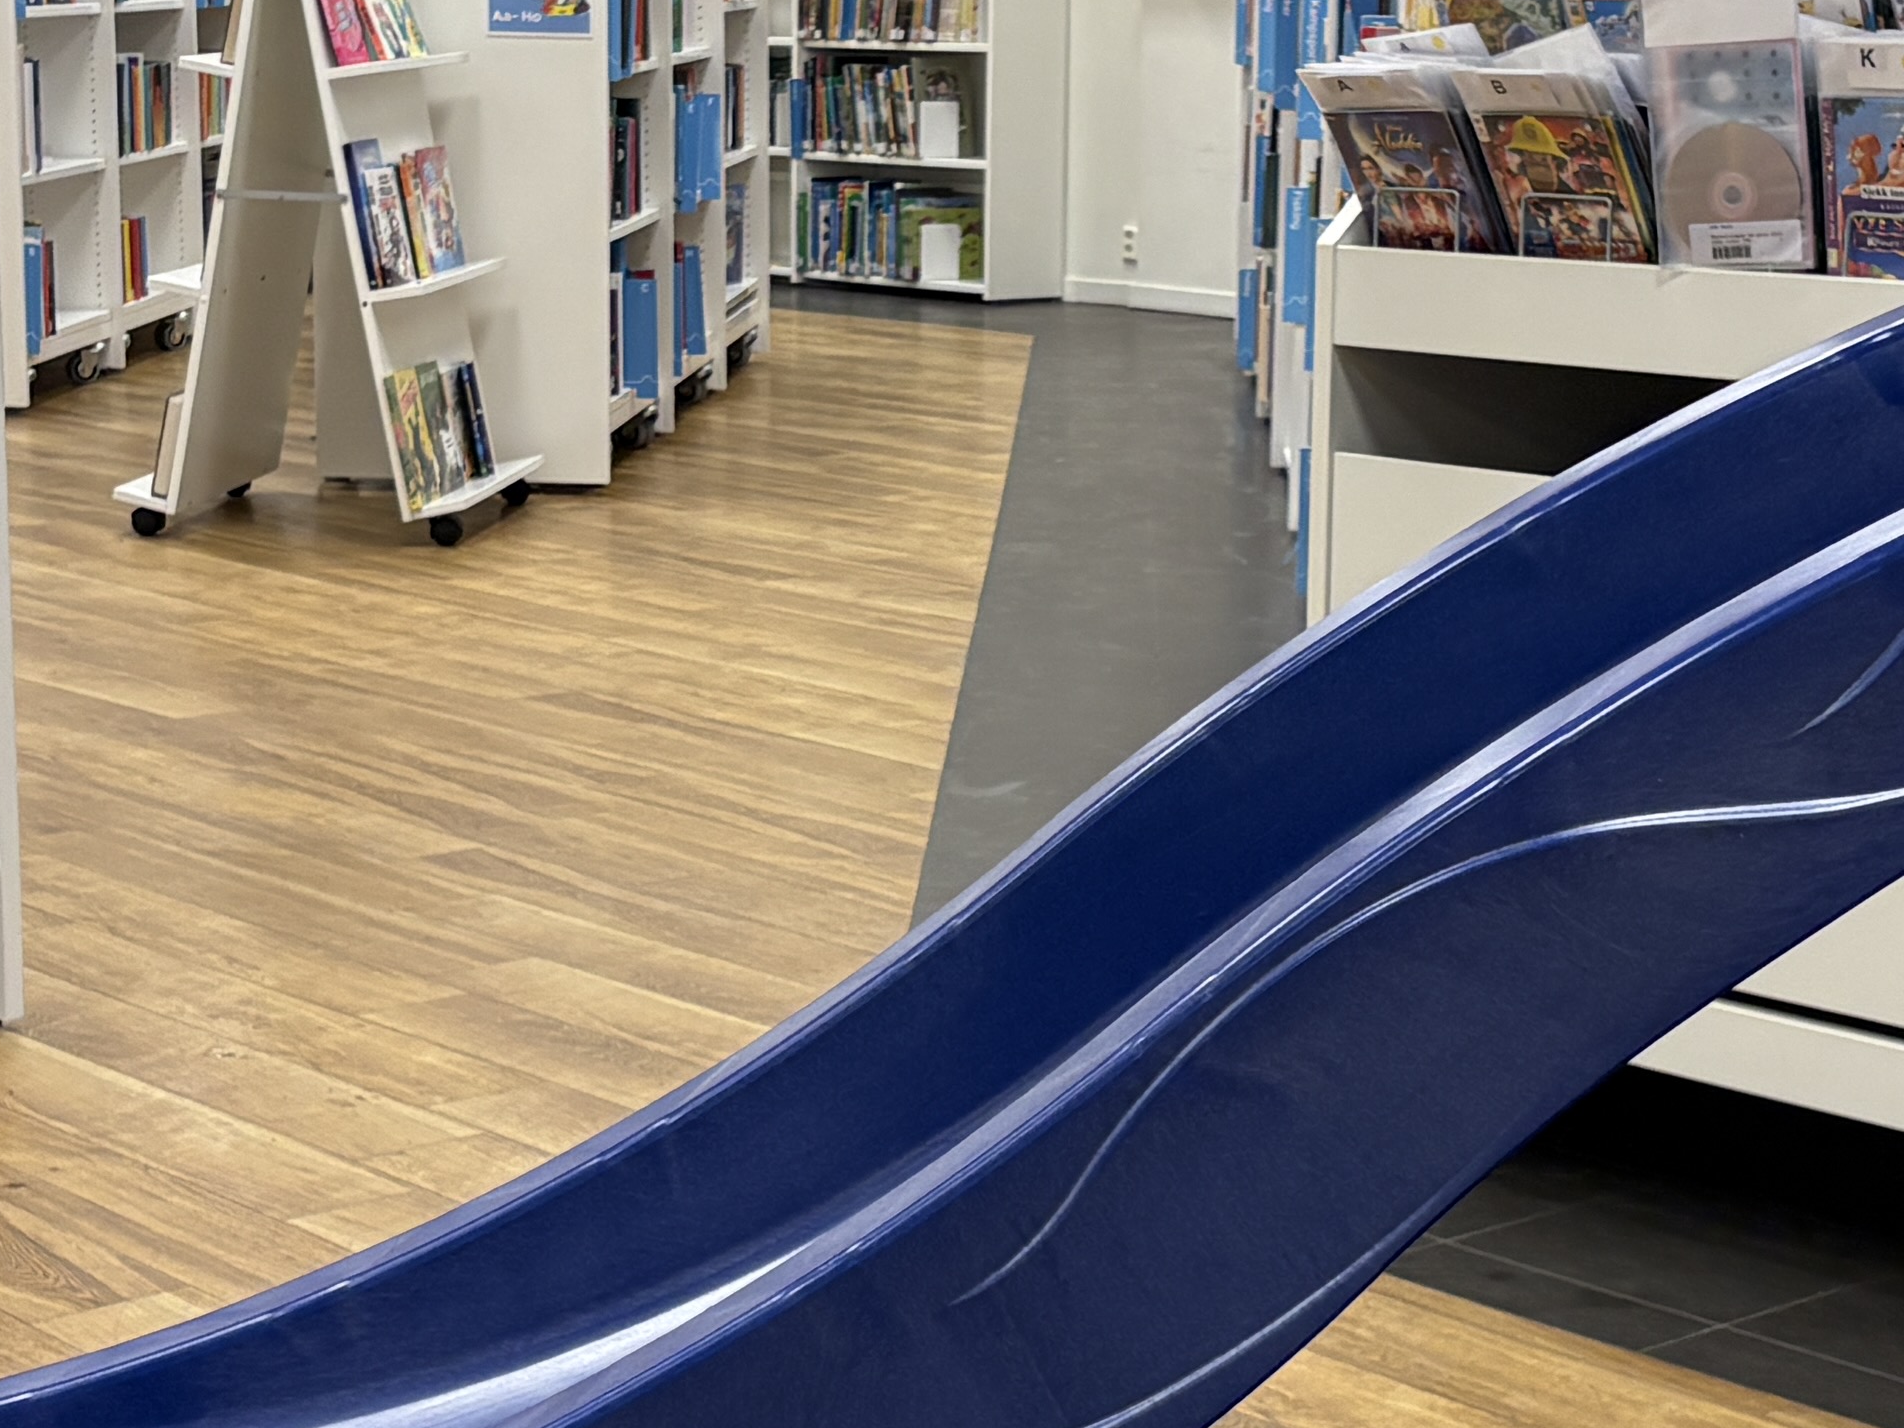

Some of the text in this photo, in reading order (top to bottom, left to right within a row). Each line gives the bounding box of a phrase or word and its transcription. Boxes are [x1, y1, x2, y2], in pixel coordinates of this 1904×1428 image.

[1860, 48, 1876, 68] K
[1337, 79, 1353, 94] A
[1492, 80, 1508, 95] B
